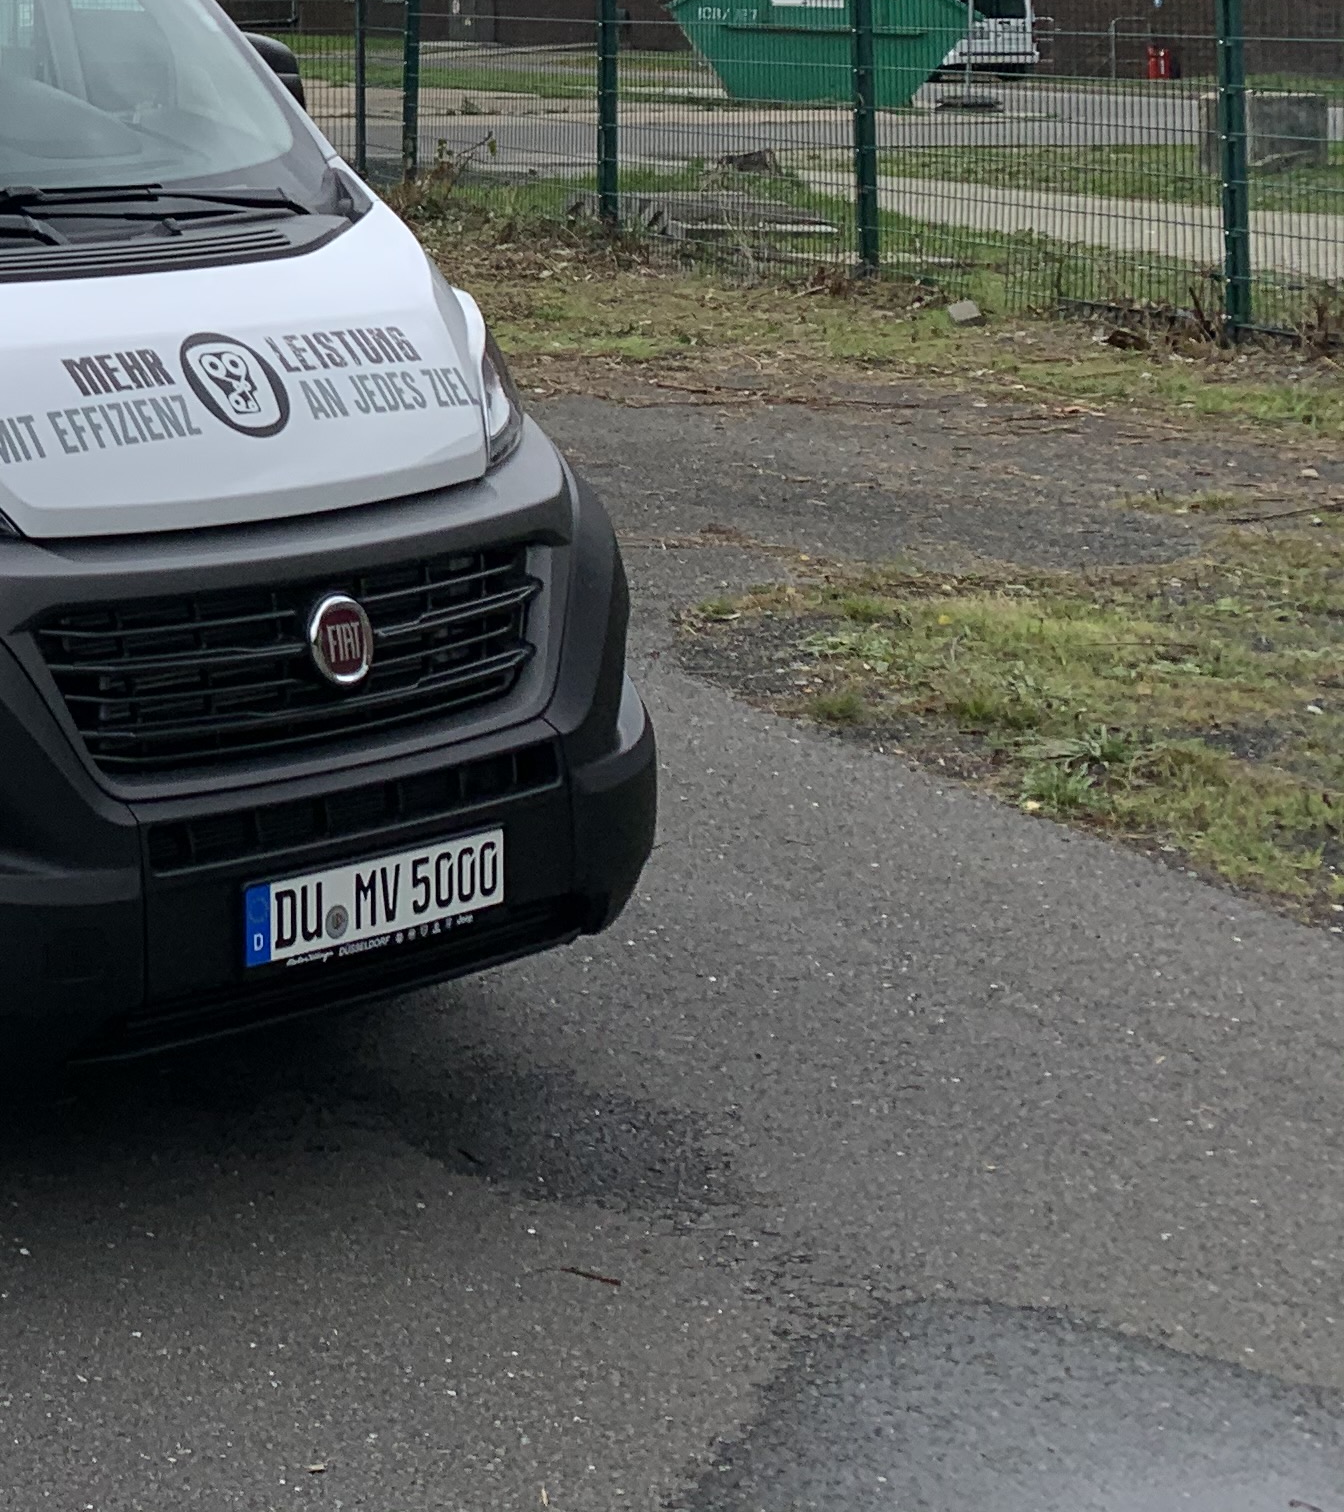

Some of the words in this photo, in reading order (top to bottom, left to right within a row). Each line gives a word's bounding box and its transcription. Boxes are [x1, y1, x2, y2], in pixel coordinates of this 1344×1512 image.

[60, 348, 177, 397] MEHR
[263, 325, 423, 373] LEISTUNG
[46, 394, 203, 455] EFFIZIENZ
[299, 377, 350, 420] AN
[348, 370, 428, 415] JEDES
[420, 366, 481, 408] ZIEL
[326, 620, 361, 663] FIAT
[274, 881, 323, 951] DU
[355, 863, 401, 930] MV
[411, 840, 498, 916] 5000
[253, 932, 265, 952] D
